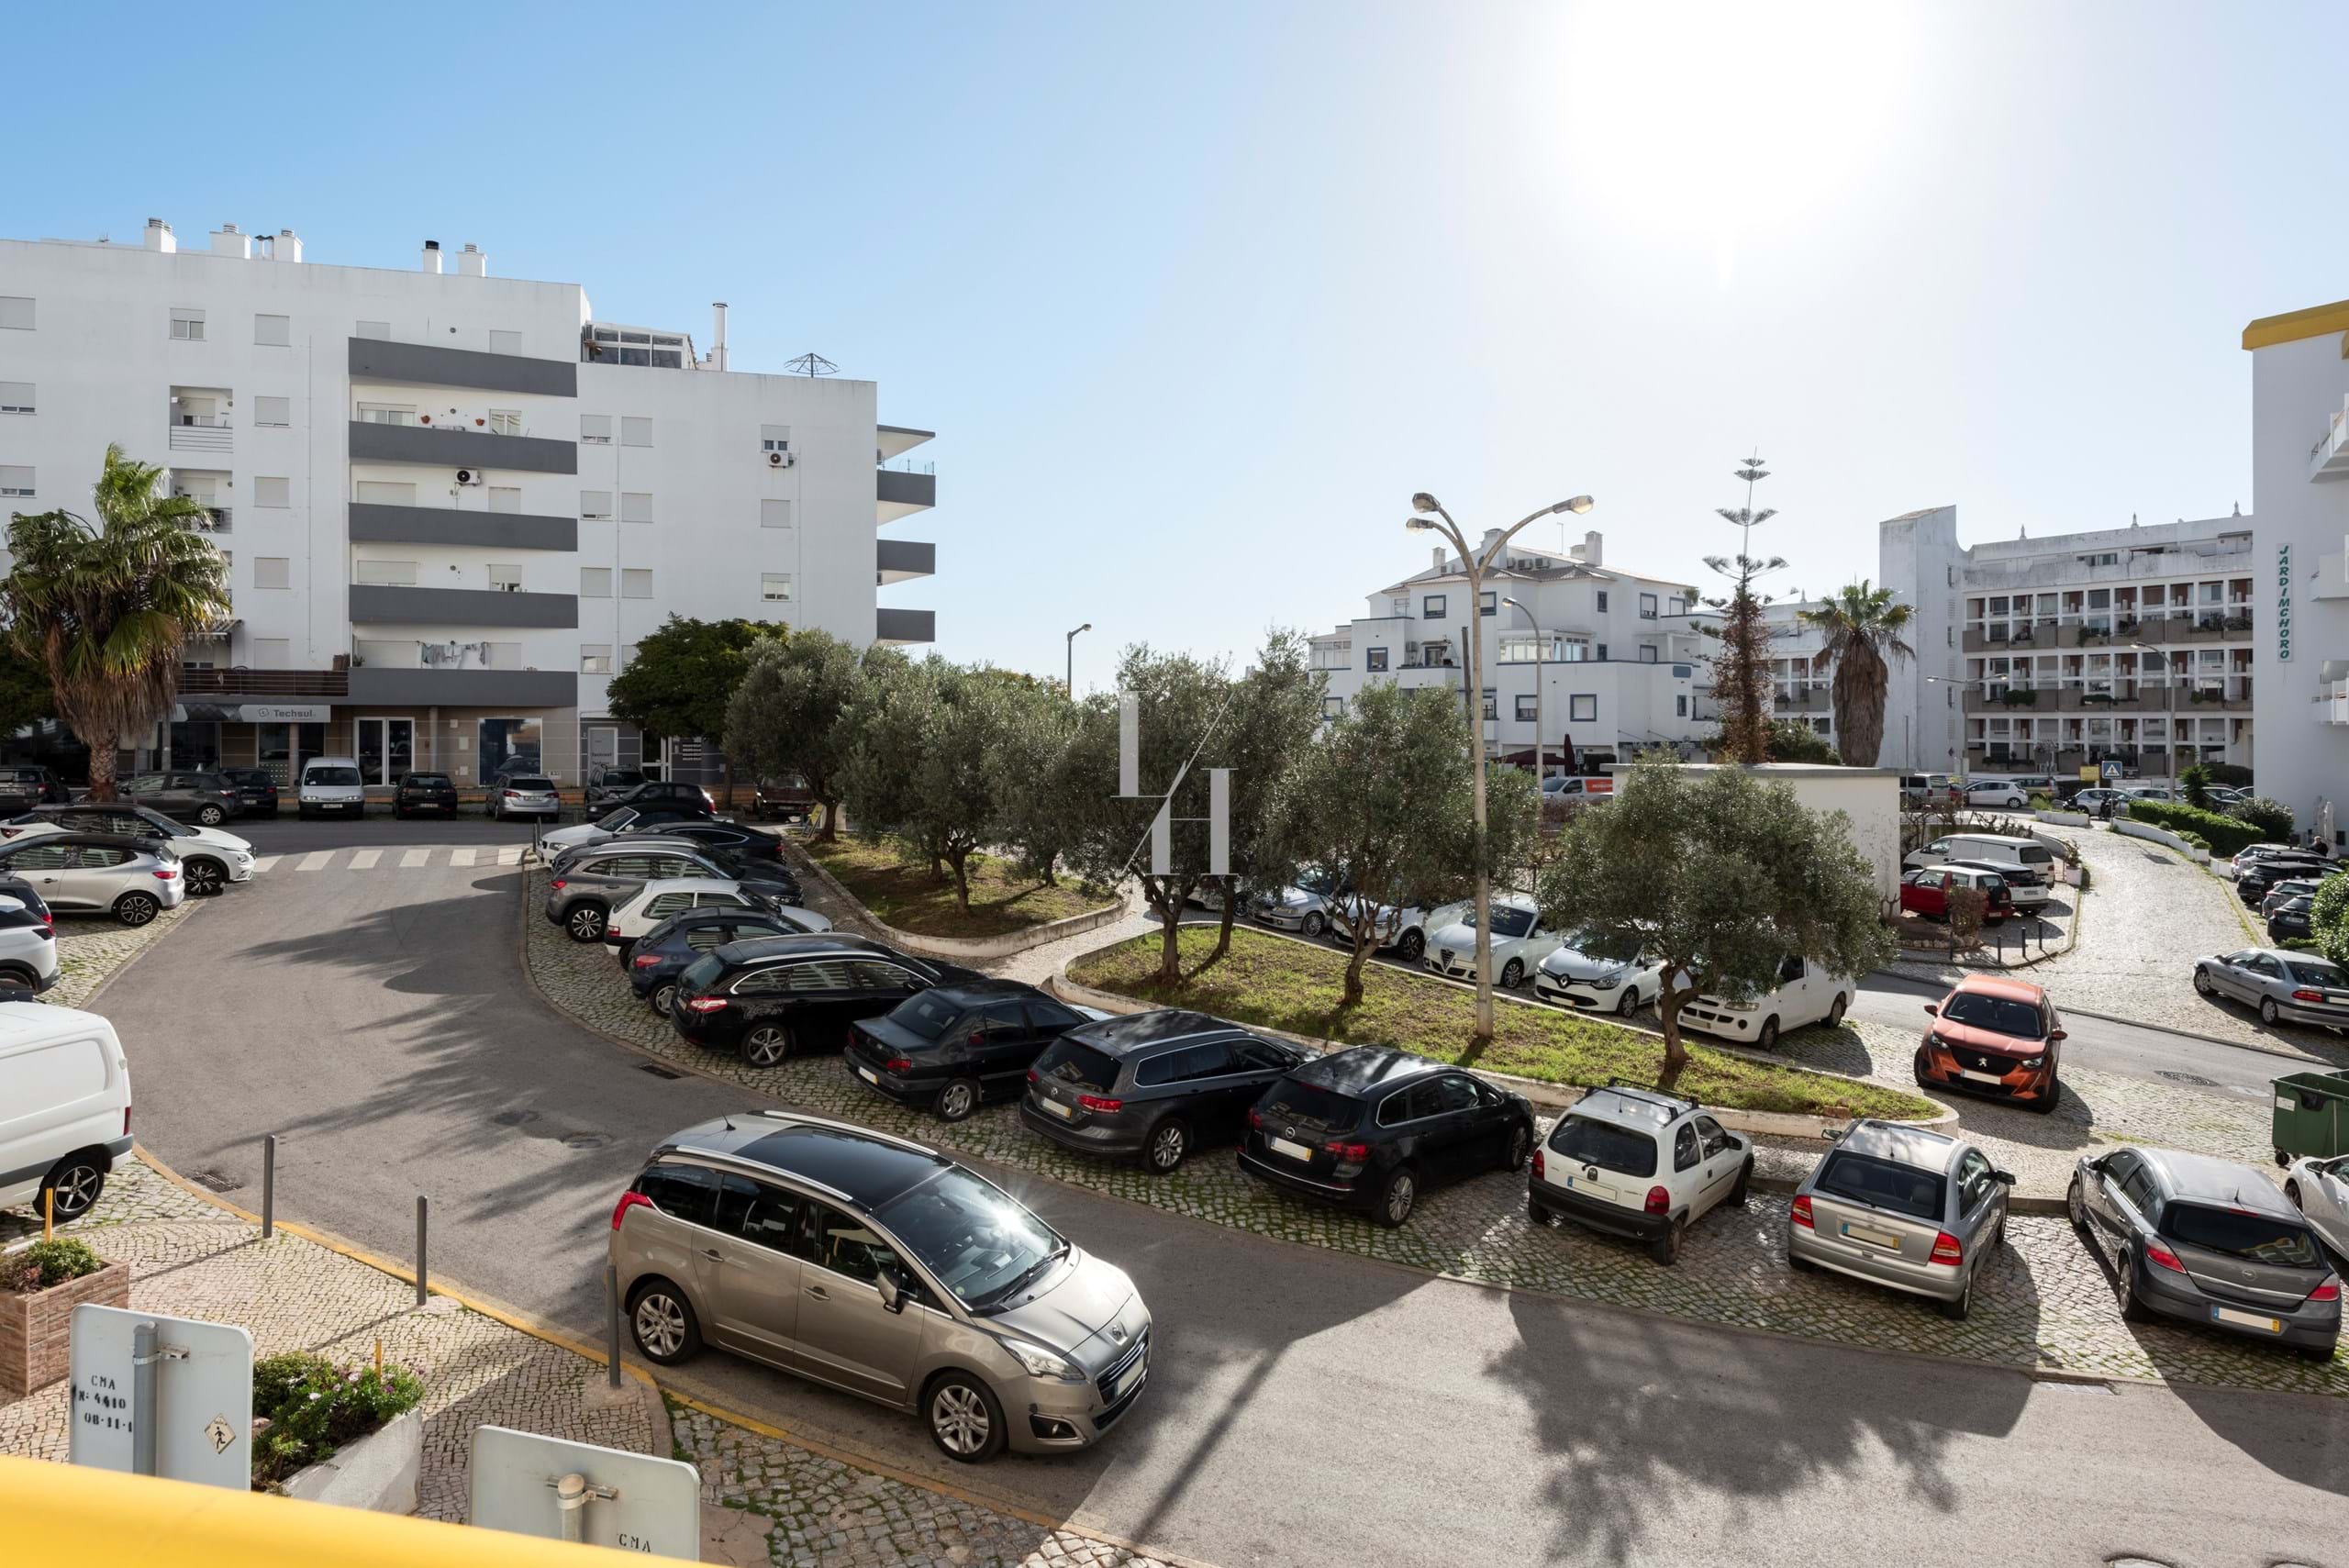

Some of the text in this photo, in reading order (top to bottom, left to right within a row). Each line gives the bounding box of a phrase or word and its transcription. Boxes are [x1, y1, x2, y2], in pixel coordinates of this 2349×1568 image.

[2278, 545, 2290, 659] JARDIMCHORO
[274, 709, 313, 717] Techsul
[92, 1375, 116, 1390] CMA
[618, 1533, 651, 1552] CMA
